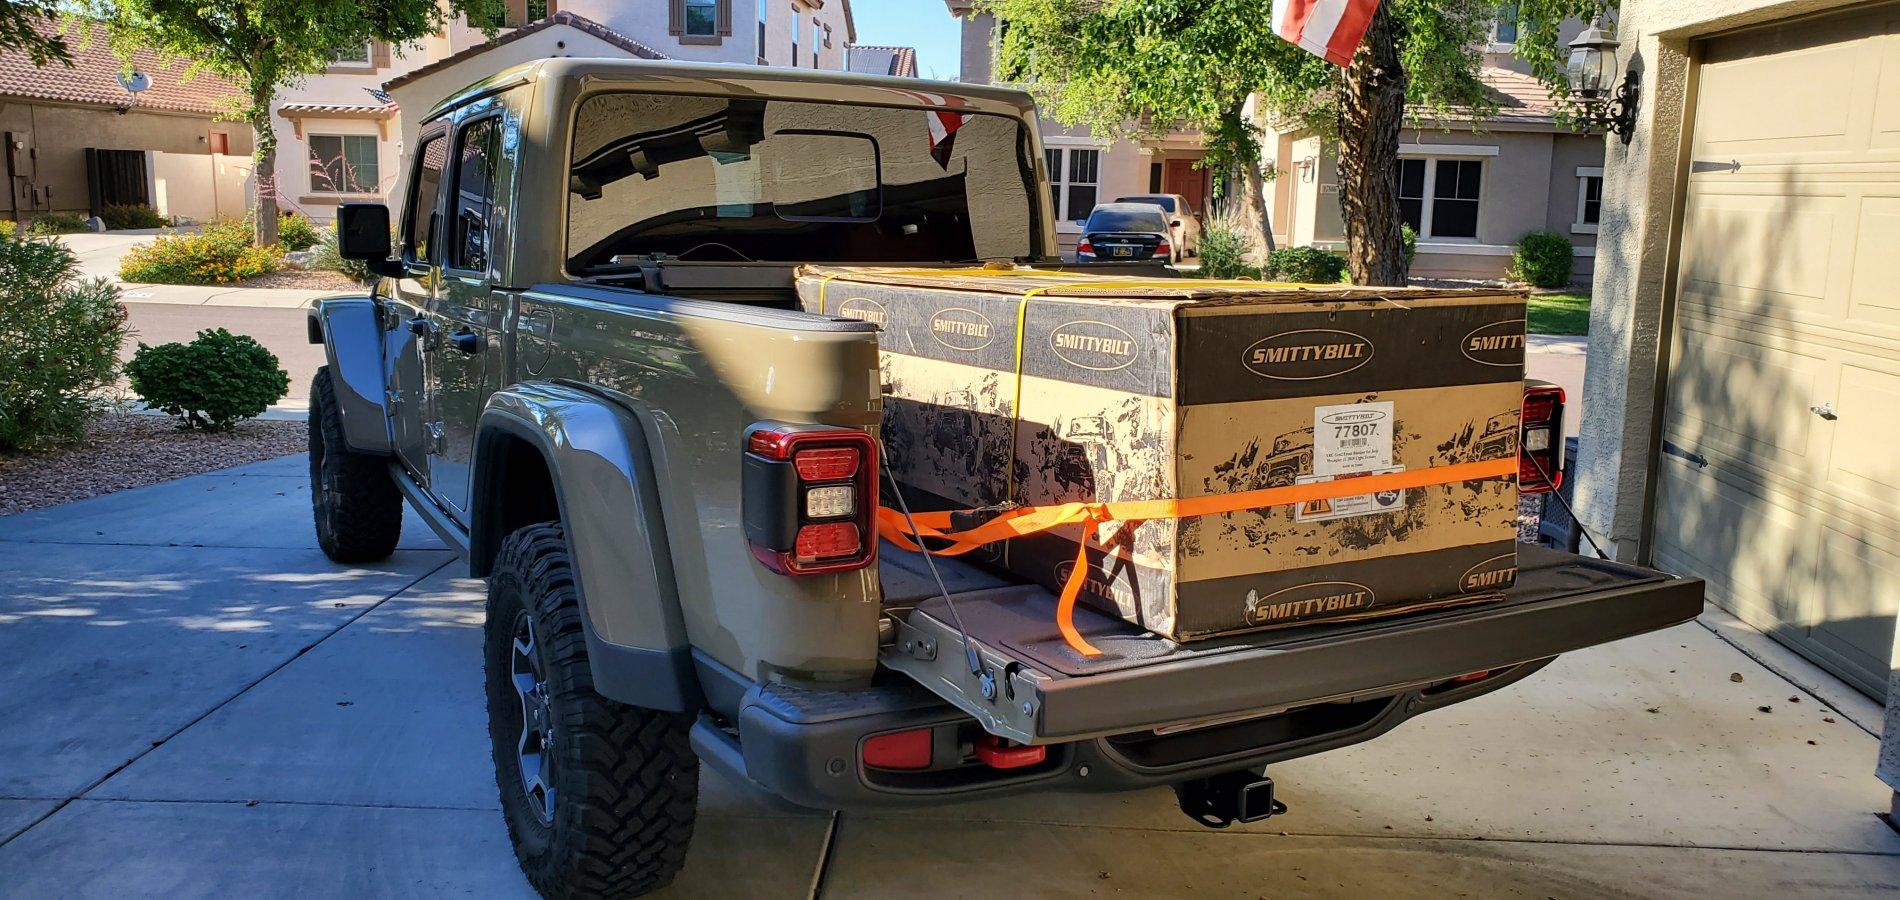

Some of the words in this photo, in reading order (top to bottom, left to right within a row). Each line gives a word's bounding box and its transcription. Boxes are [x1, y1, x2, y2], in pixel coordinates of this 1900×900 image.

[841, 307, 884, 323] SMITTYBILT
[934, 318, 989, 338] SMITTYBILT
[1056, 333, 1131, 356] SMITTYBILT
[1253, 343, 1364, 364] SMITTYBILT
[1254, 592, 1366, 621] SMITTYBILT
